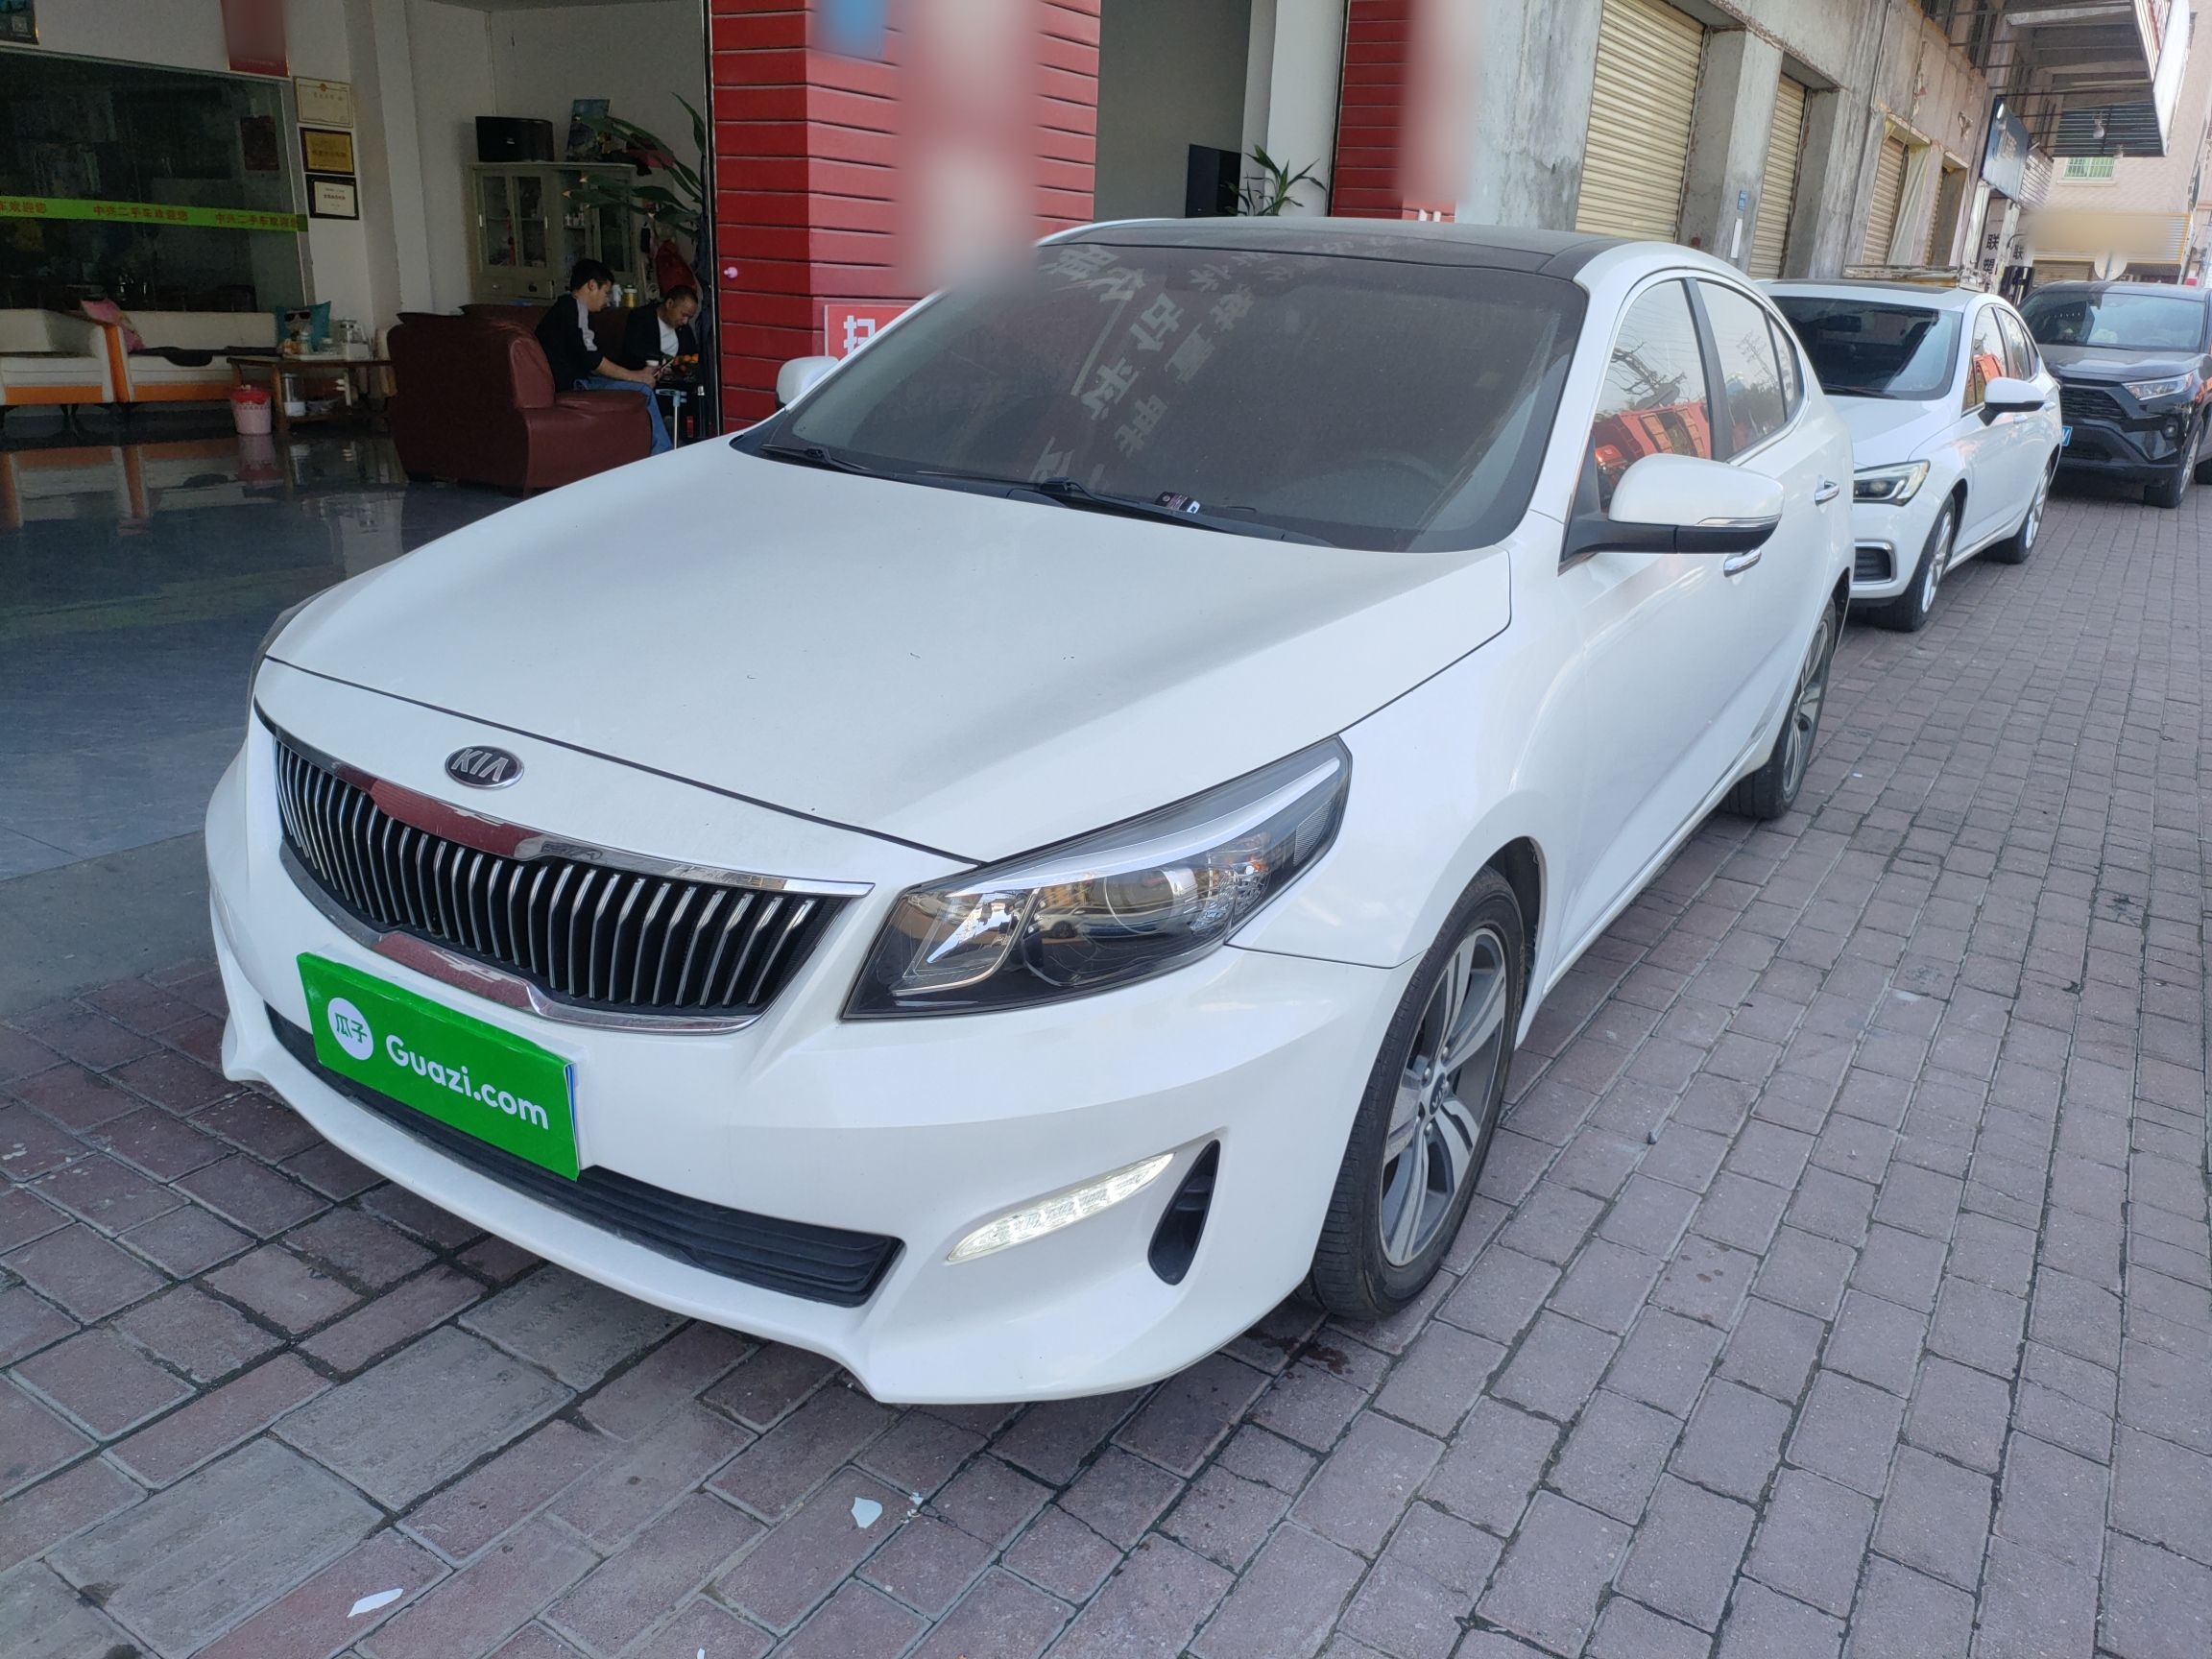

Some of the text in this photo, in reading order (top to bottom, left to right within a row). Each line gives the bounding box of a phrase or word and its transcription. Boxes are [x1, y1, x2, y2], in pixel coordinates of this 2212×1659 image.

[450, 748, 509, 782] KIA
[335, 1012, 368, 1044] 瓜子
[385, 1034, 549, 1130] Guazi.com
